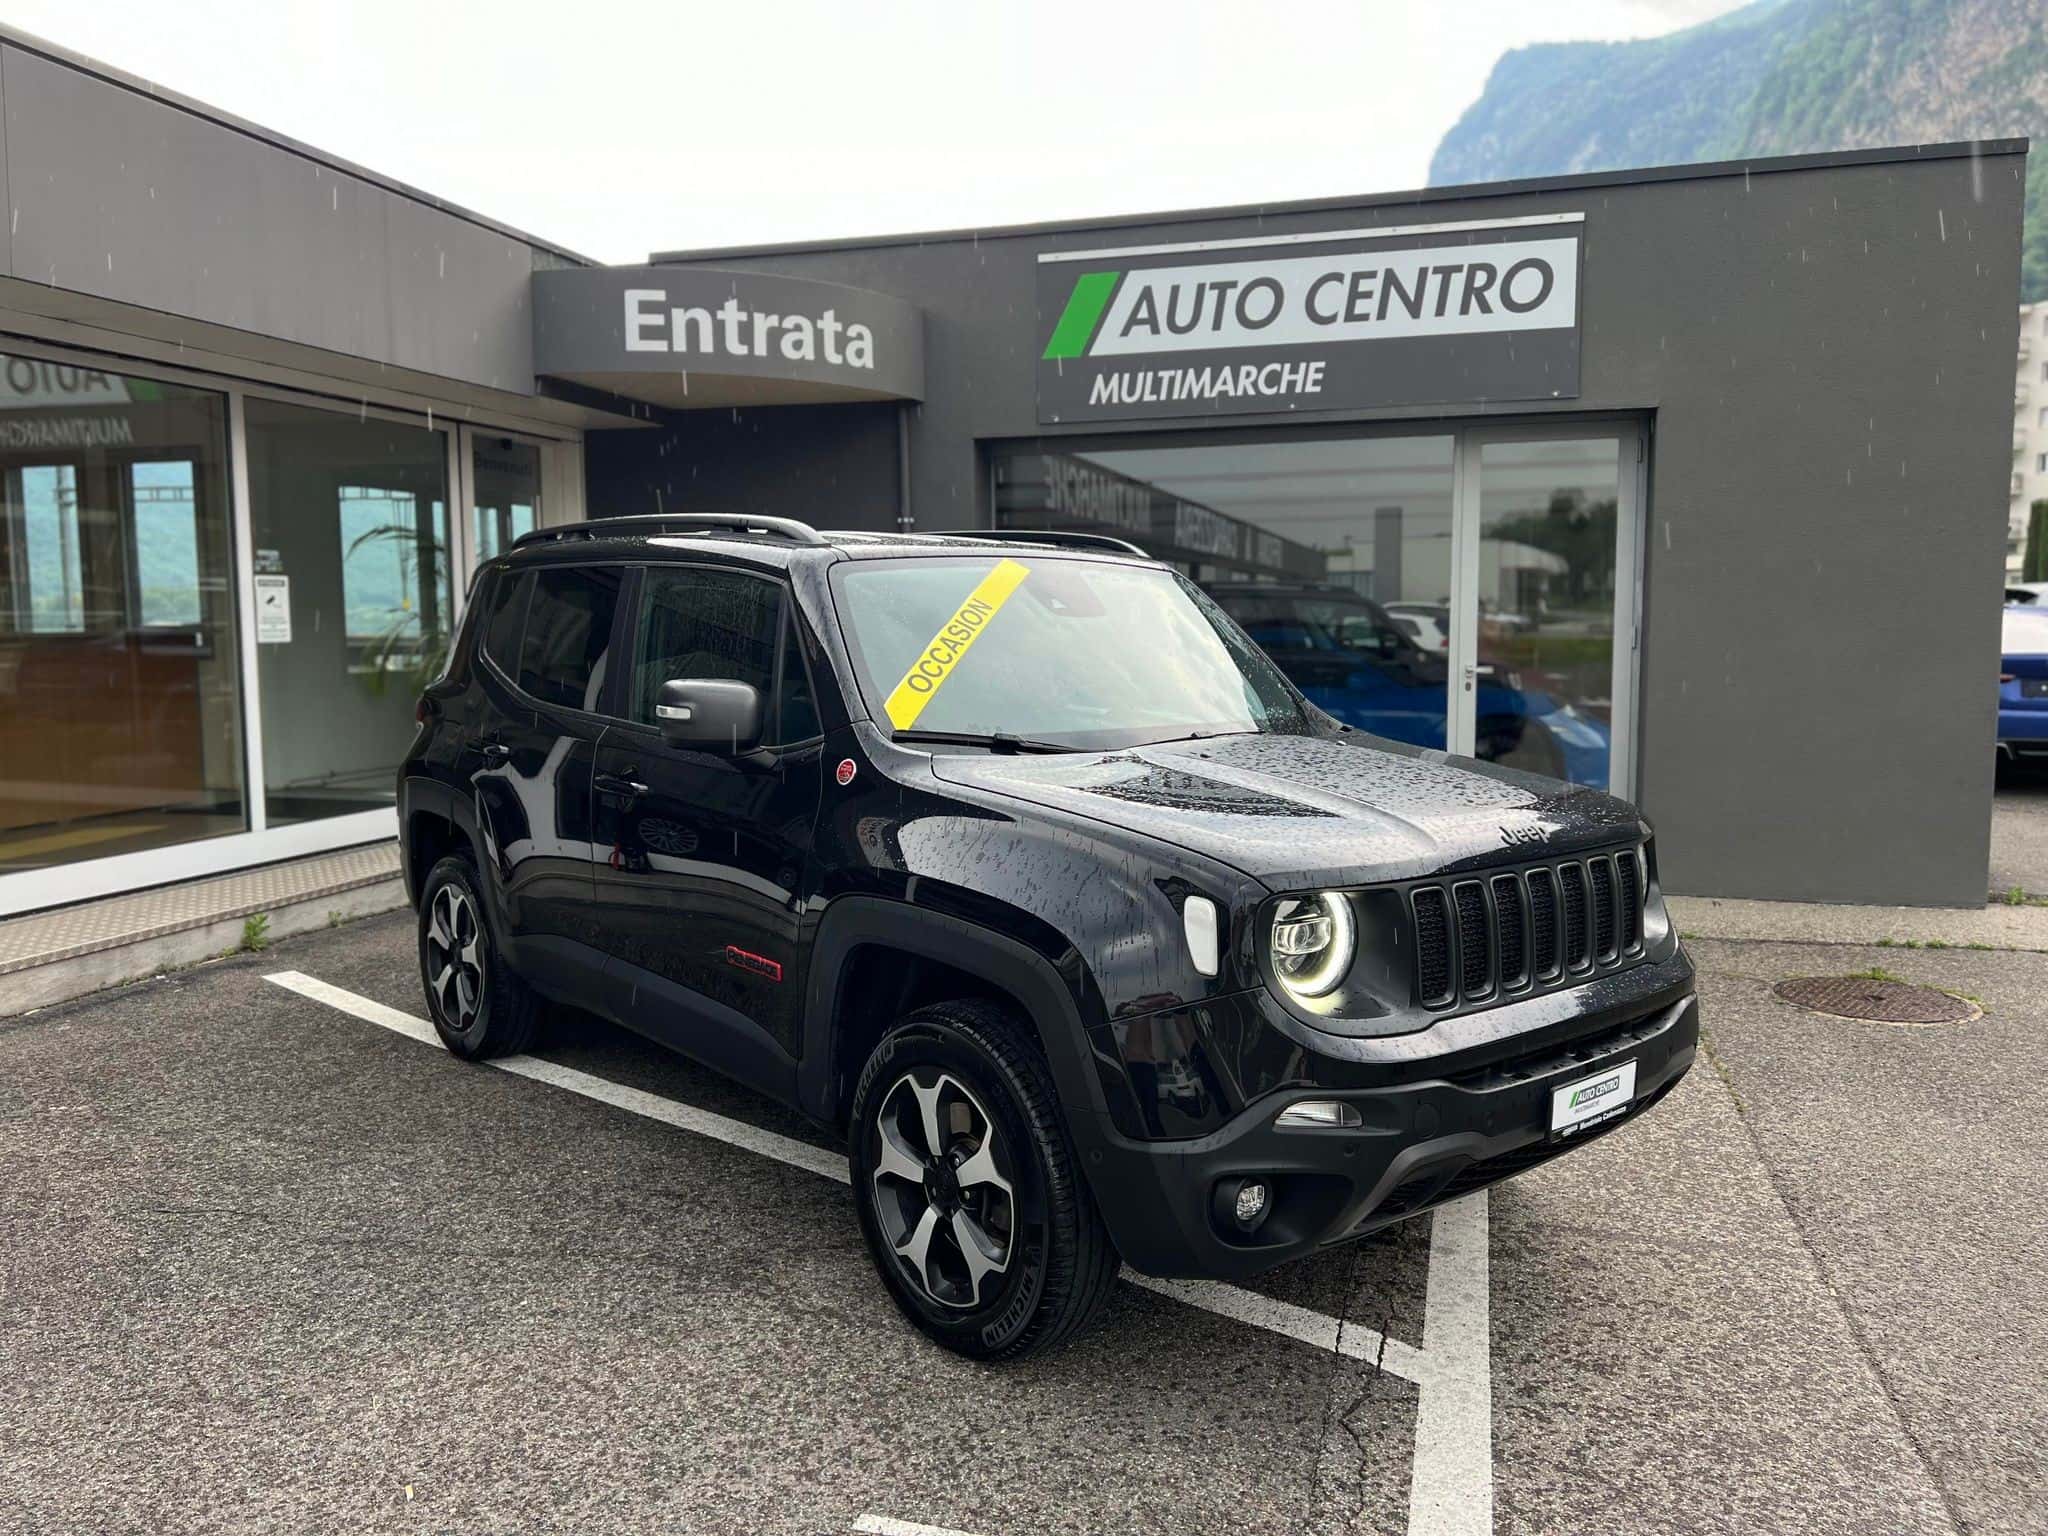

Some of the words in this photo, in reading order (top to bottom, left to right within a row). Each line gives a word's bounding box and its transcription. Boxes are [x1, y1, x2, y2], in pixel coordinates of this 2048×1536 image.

[1120, 275, 1285, 338] AUTO
[1305, 257, 1554, 326] CENTRO
[623, 289, 875, 369] Entrata
[1089, 361, 1326, 405] MULTIMARCHE
[907, 598, 993, 694] OCCASION
[1499, 825, 1551, 845] Jeep
[1577, 1087, 1596, 1103] AUTO
[1595, 1078, 1619, 1097] CENTRO
